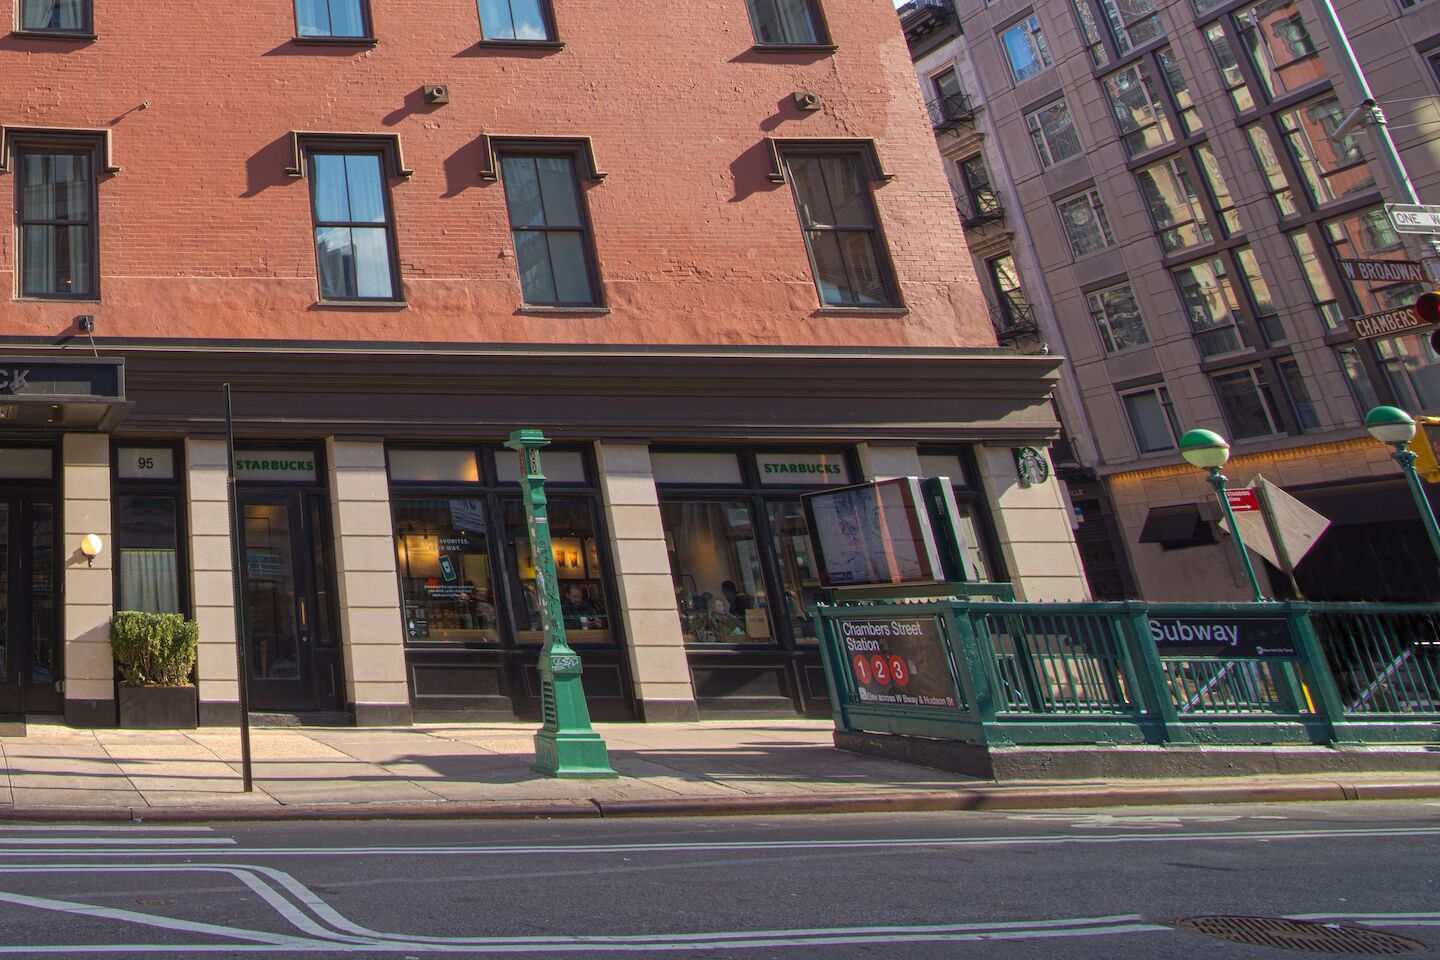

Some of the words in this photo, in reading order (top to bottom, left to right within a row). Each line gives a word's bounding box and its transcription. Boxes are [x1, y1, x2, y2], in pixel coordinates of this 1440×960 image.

[1396, 213, 1421, 224] ONE
[1342, 262, 1356, 279] W
[1358, 262, 1424, 281] BROADWAY
[1355, 308, 1418, 337] CHAMBERS
[138, 457, 154, 469] 95
[236, 460, 314, 472] STARBUCKS
[763, 463, 841, 474] STARBUCKS
[843, 622, 891, 635] Chambers
[891, 621, 923, 635] Street
[1148, 619, 1238, 646] Subway
[846, 637, 880, 651] Station
[858, 660, 866, 678] 1
[875, 661, 885, 678] 2
[893, 661, 903, 679] 3
[895, 694, 902, 702] W
[924, 696, 946, 705] Hudson
[946, 697, 954, 706] St
